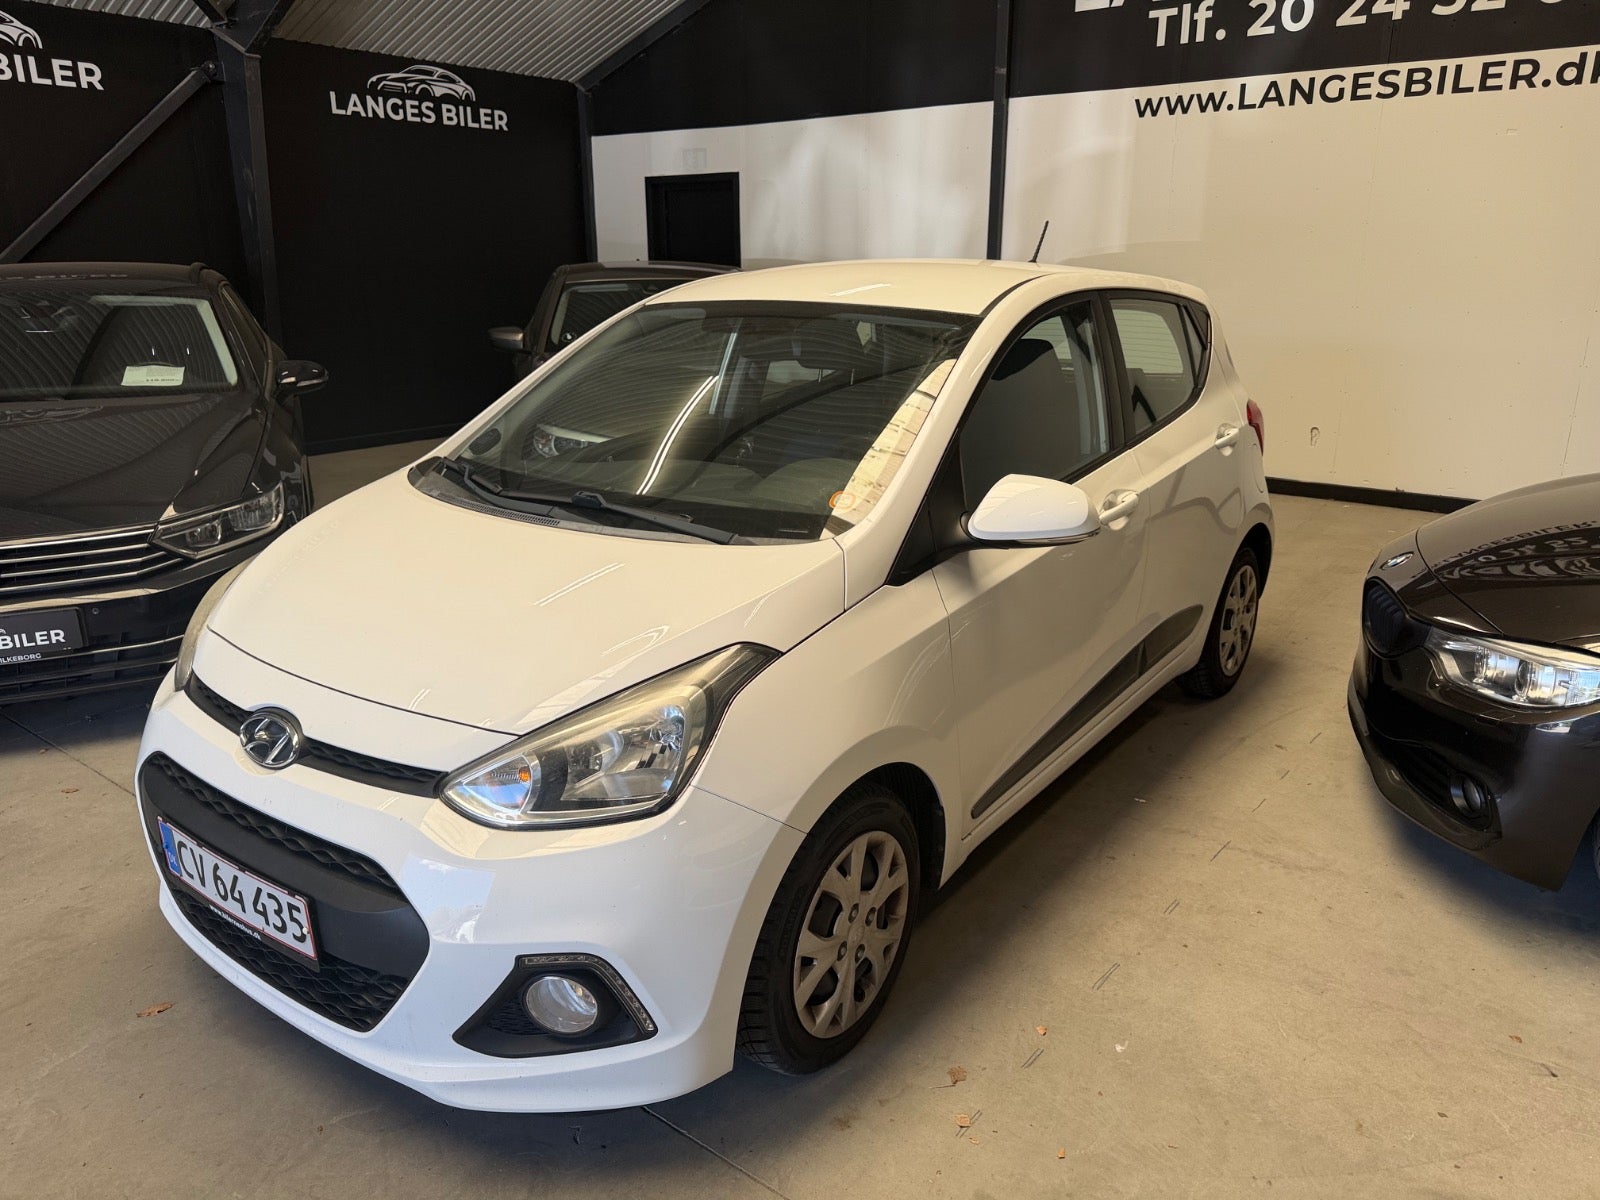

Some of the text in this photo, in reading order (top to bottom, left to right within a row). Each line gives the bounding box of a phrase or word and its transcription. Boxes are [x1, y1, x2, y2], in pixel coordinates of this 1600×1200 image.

[1148, 0, 1227, 47] Tlf.
[1246, 0, 1315, 37] 20
[329, 90, 509, 132] LANGES BILER
[0, 629, 66, 650] BILER
[0, 652, 42, 664] ILKEBORG
[177, 840, 307, 944] CV 64 435
